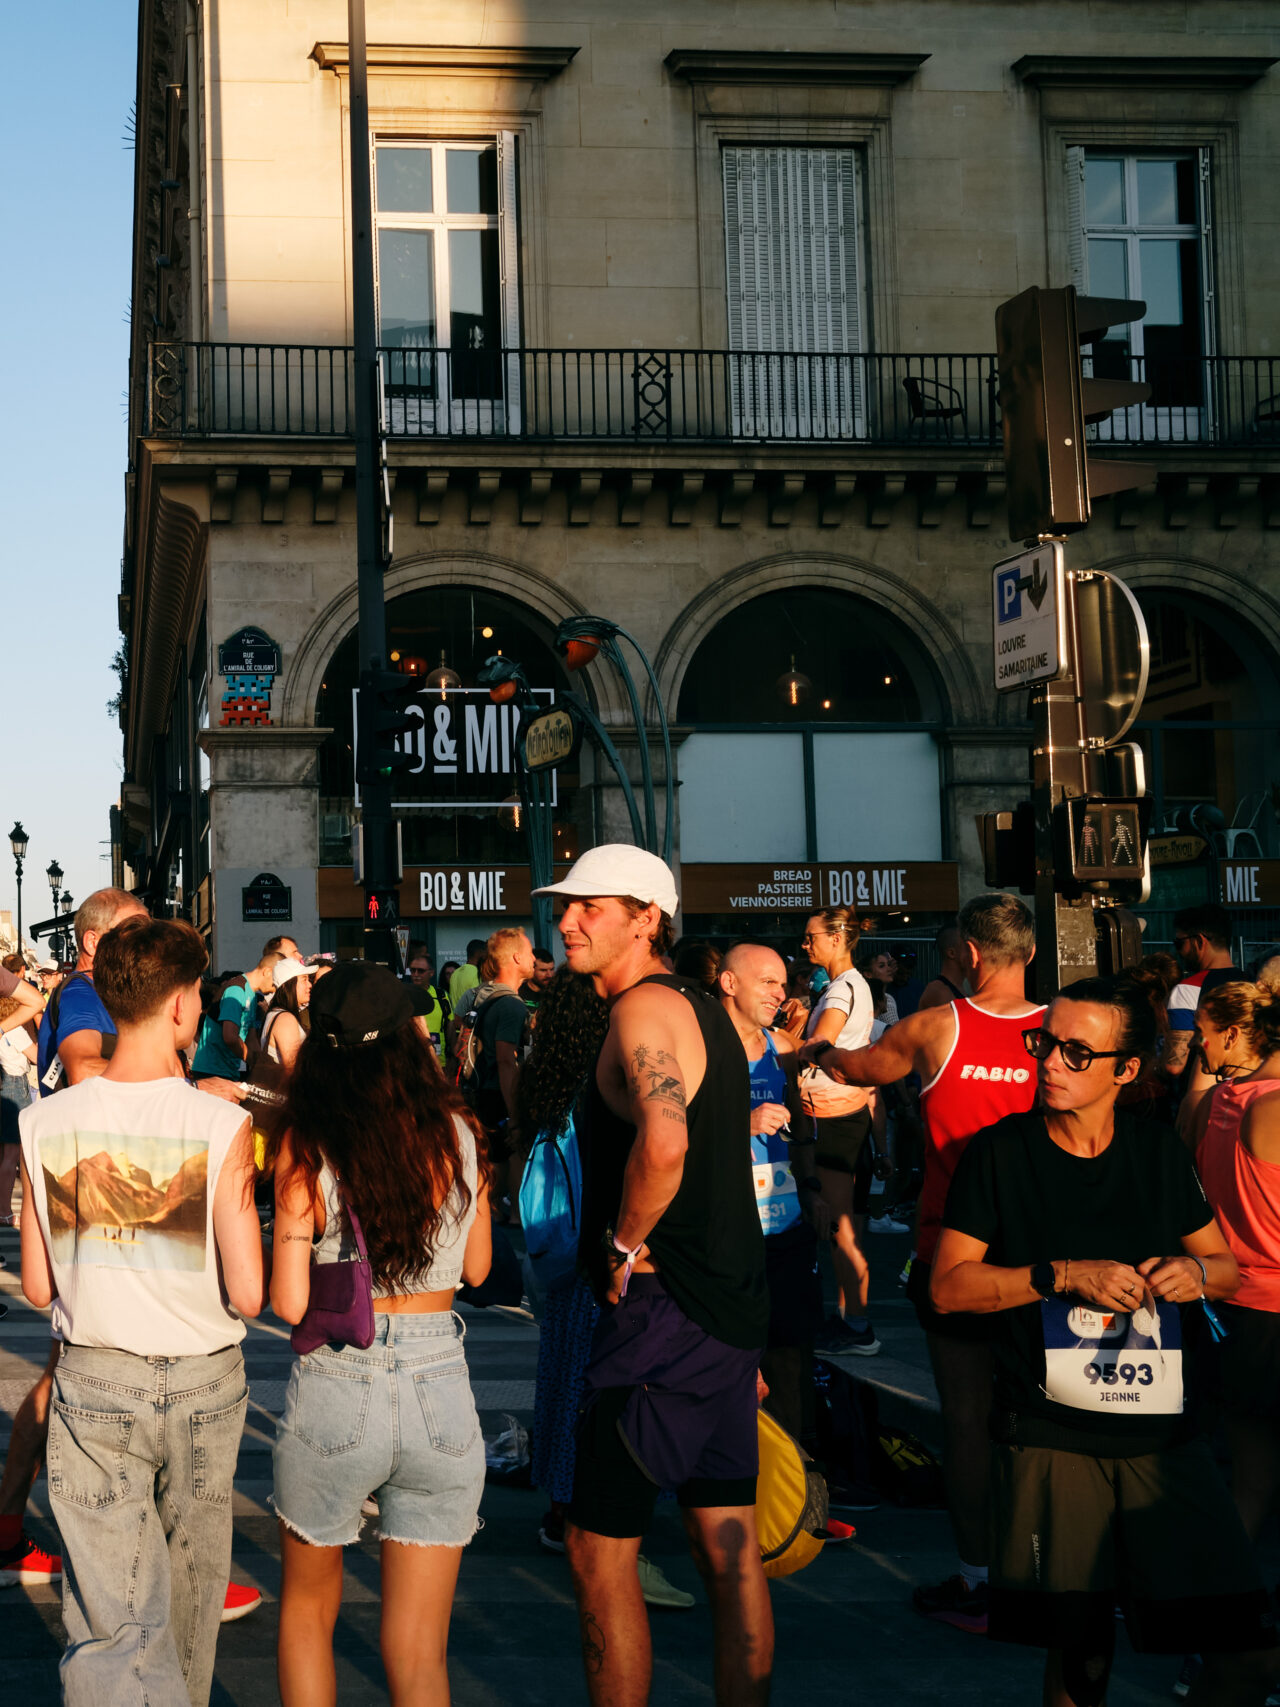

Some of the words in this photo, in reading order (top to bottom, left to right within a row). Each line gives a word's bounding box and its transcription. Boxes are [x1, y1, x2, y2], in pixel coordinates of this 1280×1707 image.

[1003, 579, 1016, 614] P
[998, 634, 1026, 655] LOUVRE
[242, 651, 255, 659] RUE
[223, 664, 245, 672] L'AMIRAL
[998, 653, 1048, 679] SAMARITAINE
[433, 704, 458, 774] &
[464, 704, 530, 774] MI
[773, 870, 812, 881] BREAD
[1226, 866, 1261, 902] MIE
[420, 871, 447, 911] BO
[450, 871, 464, 911] &
[468, 871, 506, 911] MIE
[758, 883, 813, 894] PASTRIES
[828, 870, 854, 907] BO
[857, 870, 869, 906] &
[872, 870, 908, 906] MIE
[729, 896, 813, 907] VIENNOISERIE
[960, 1065, 1030, 1084] FABIO
[750, 1090, 775, 1100] ALIA
[1083, 1363, 1154, 1386] 9593
[1100, 1392, 1141, 1402] JEANNE
